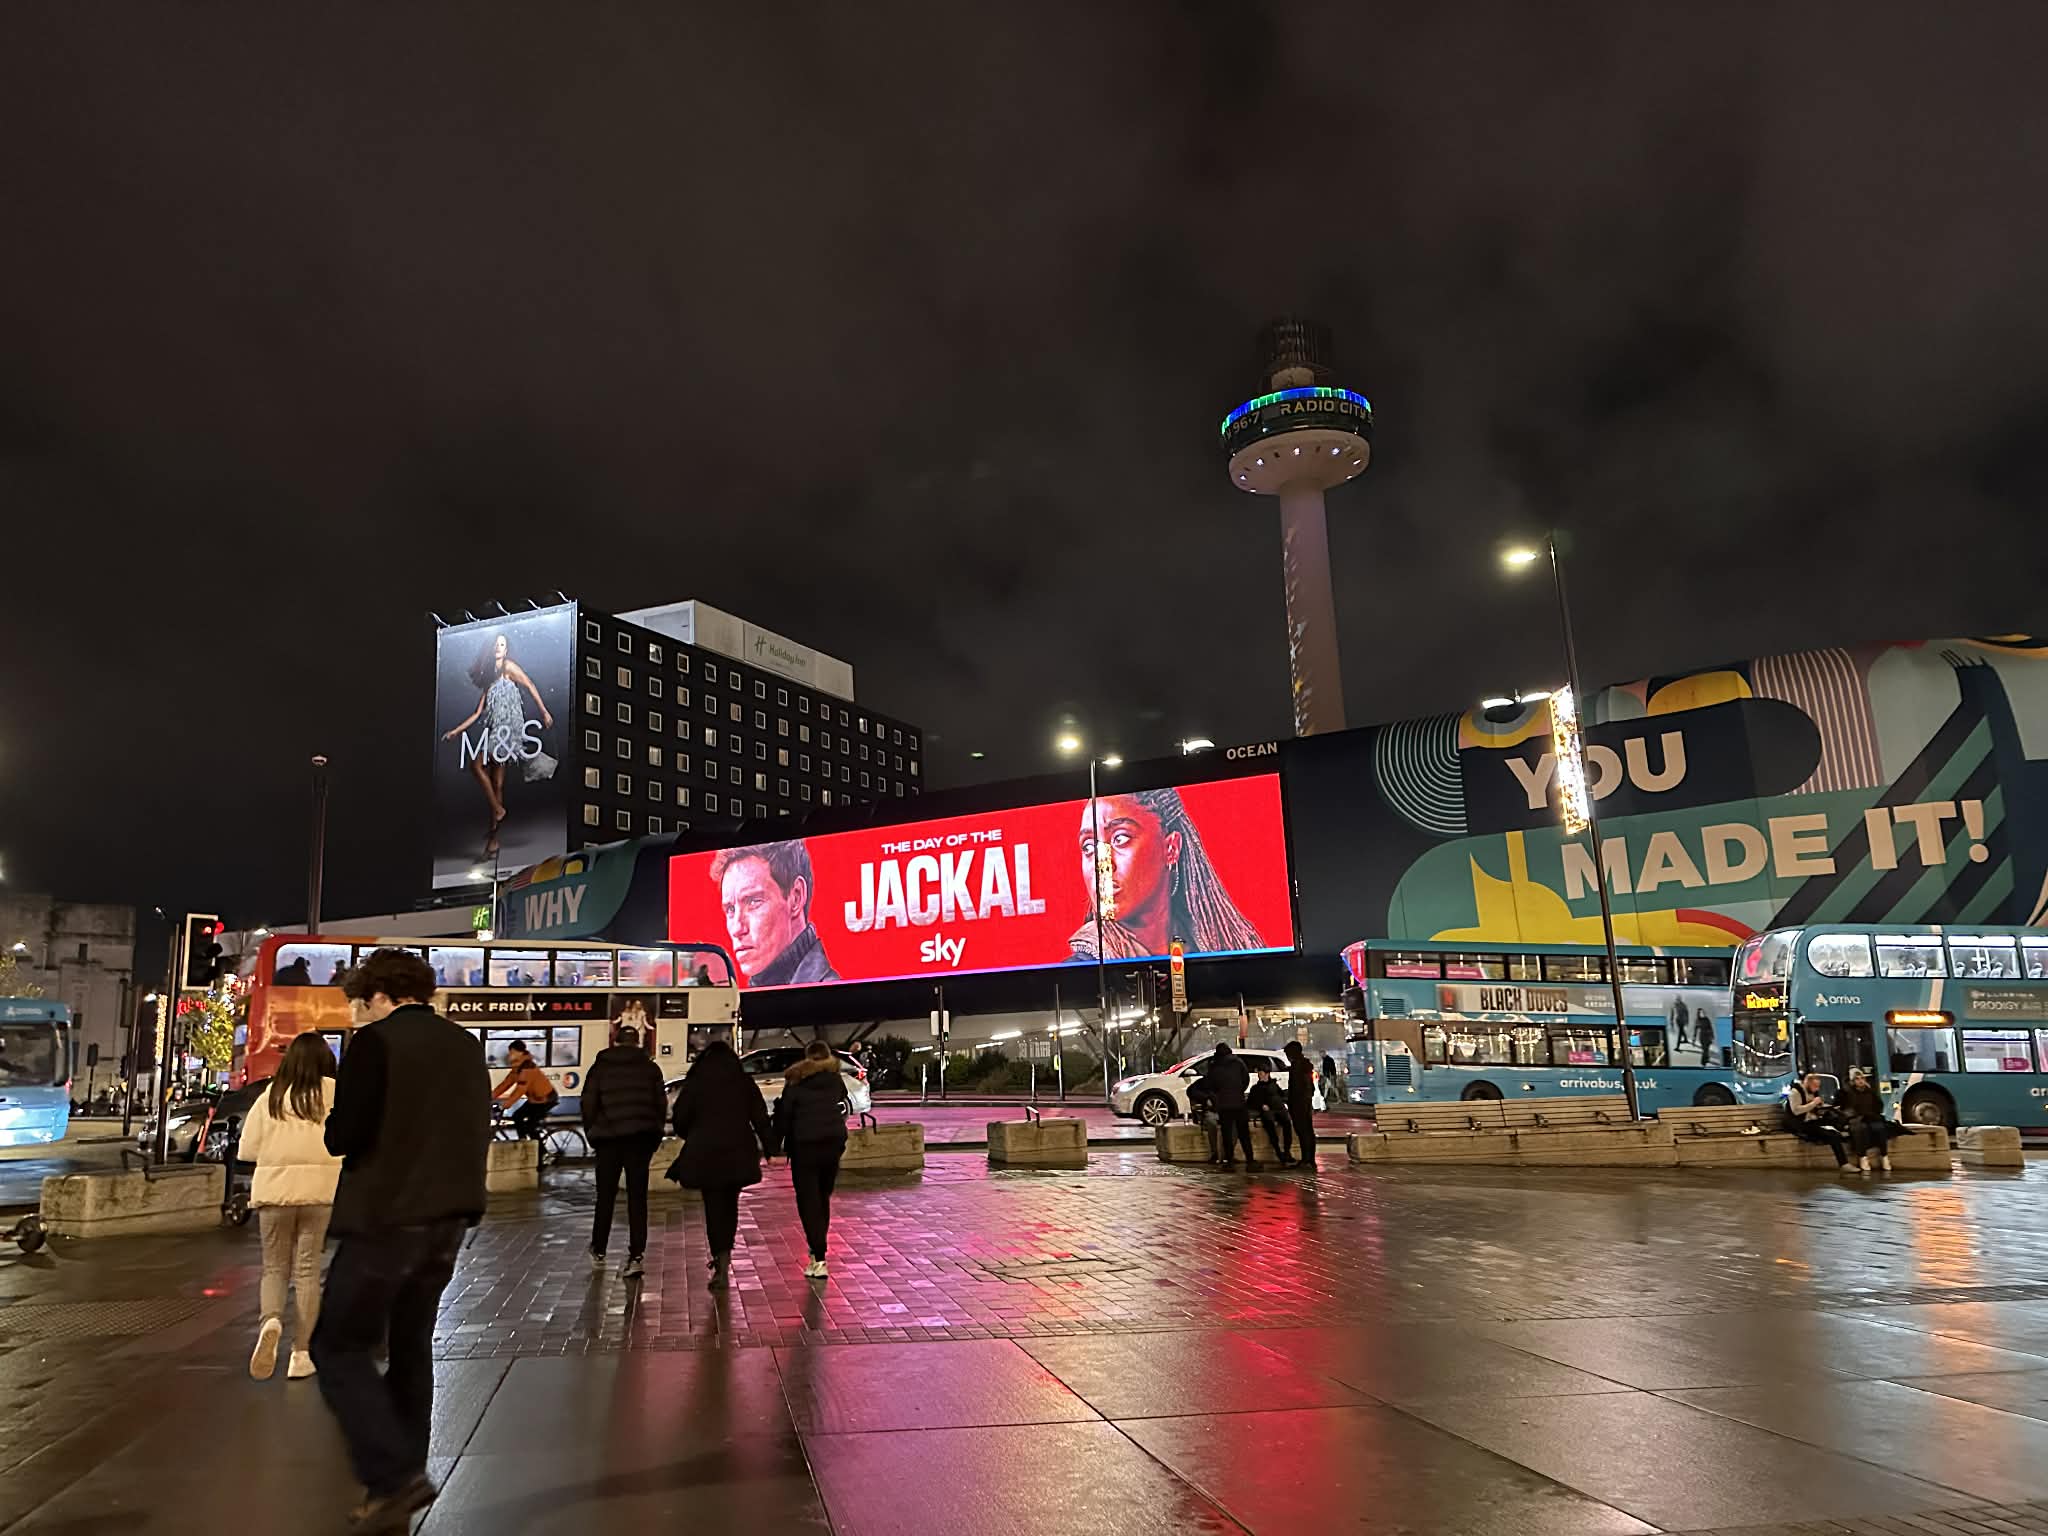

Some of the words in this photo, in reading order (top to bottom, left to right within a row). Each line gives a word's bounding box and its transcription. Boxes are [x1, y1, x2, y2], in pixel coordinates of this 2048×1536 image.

[1280, 399, 1335, 415] RADIO
[769, 643, 795, 665] Holiday
[459, 719, 543, 769] M&S
[1226, 741, 1278, 760] OCEAN
[1504, 731, 1687, 810] YOU
[881, 841, 912, 855] THE
[913, 836, 944, 850] DAY
[945, 833, 968, 847] OF
[970, 828, 1003, 844] THE
[1560, 813, 1837, 900] MADE
[1864, 799, 1990, 870] IT!
[844, 842, 1047, 933] JACKAL
[524, 884, 587, 931] WHY
[919, 932, 967, 967] sky
[488, 1002, 548, 1012] FRIDAY
[551, 1001, 593, 1012] SALE
[1480, 988, 1524, 1012] BLACK
[1828, 995, 1861, 1004] arriva
